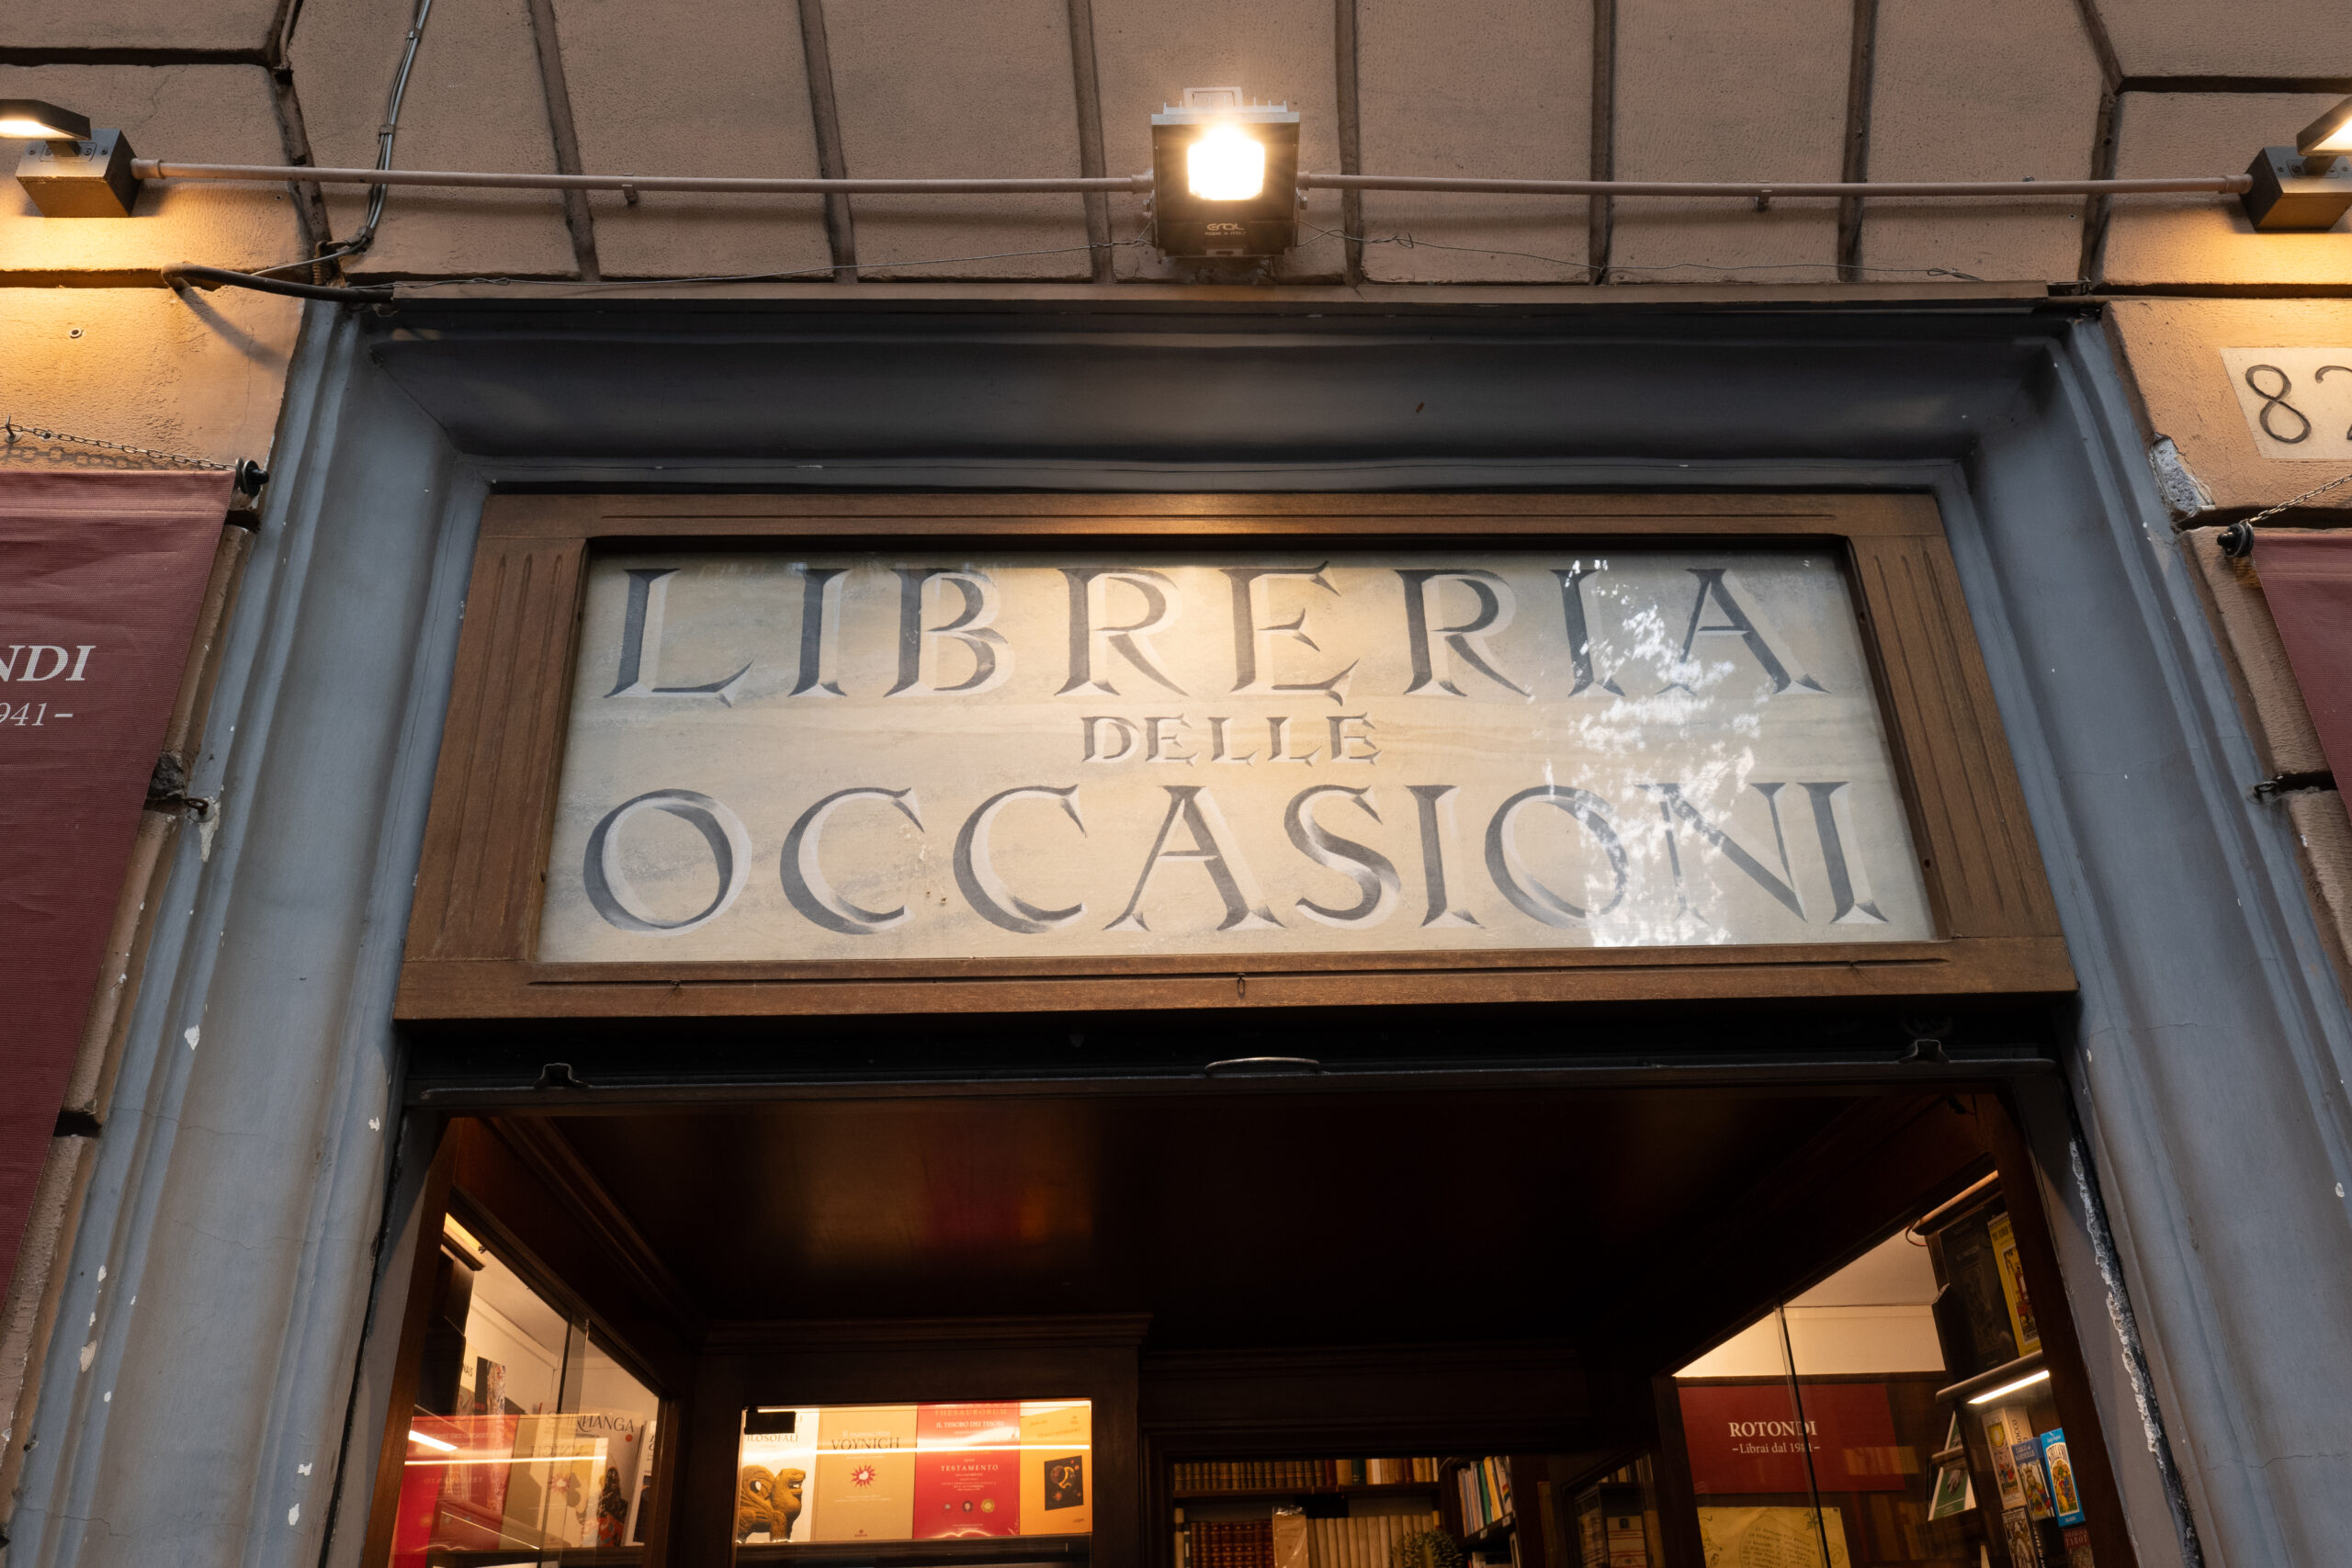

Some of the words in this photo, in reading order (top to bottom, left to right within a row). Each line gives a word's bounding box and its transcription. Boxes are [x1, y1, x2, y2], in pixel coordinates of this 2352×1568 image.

[604, 561, 1830, 707] LIBRERIA
[1081, 712, 1382, 767] DELLE
[583, 782, 1890, 937] OCCASIONI
[831, 1437, 899, 1450] VOYNICH
[1771, 1442, 1786, 1453] dal
